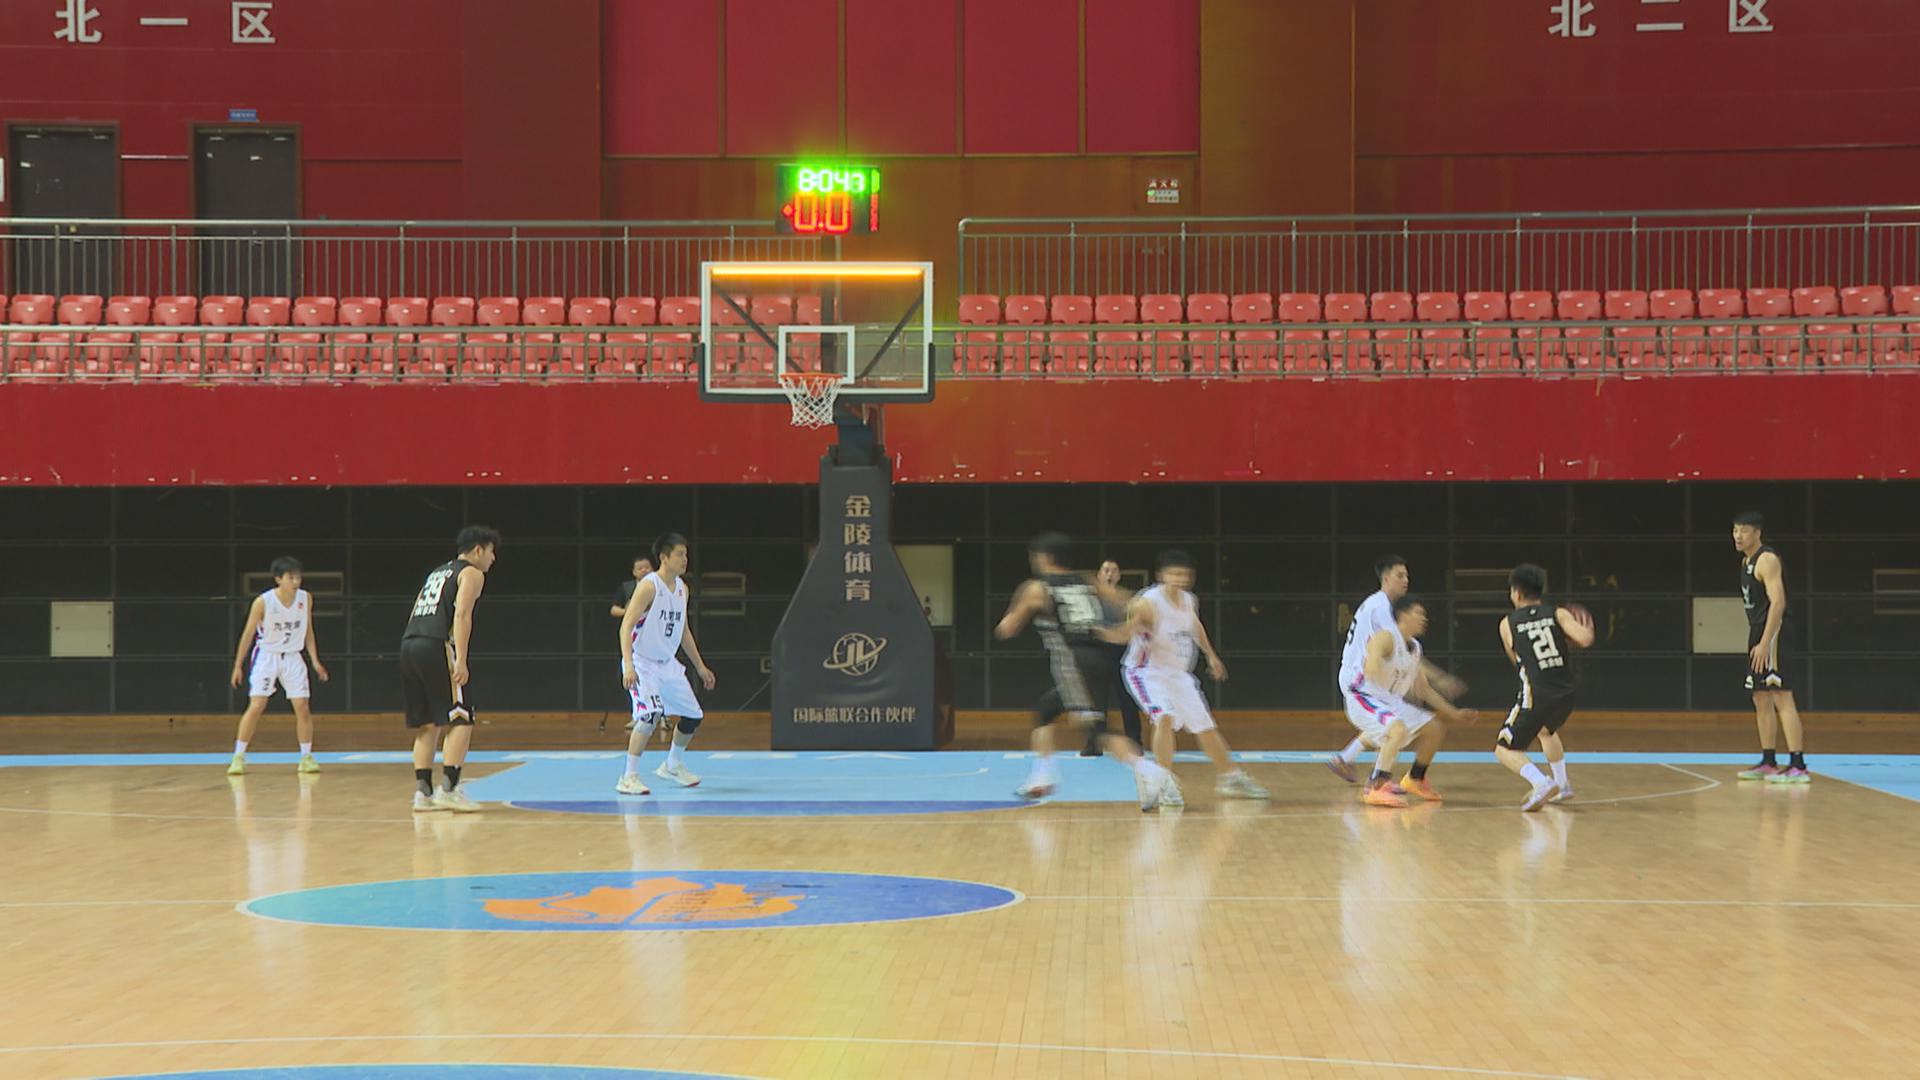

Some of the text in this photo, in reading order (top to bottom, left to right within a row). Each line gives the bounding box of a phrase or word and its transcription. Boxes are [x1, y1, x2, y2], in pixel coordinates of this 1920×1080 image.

[53, 0, 276, 43] 北一区
[844, 495, 872, 601] 金陵体育
[1527, 626, 1560, 661] 21
[793, 706, 917, 723] 国际篮联合作伙伴
